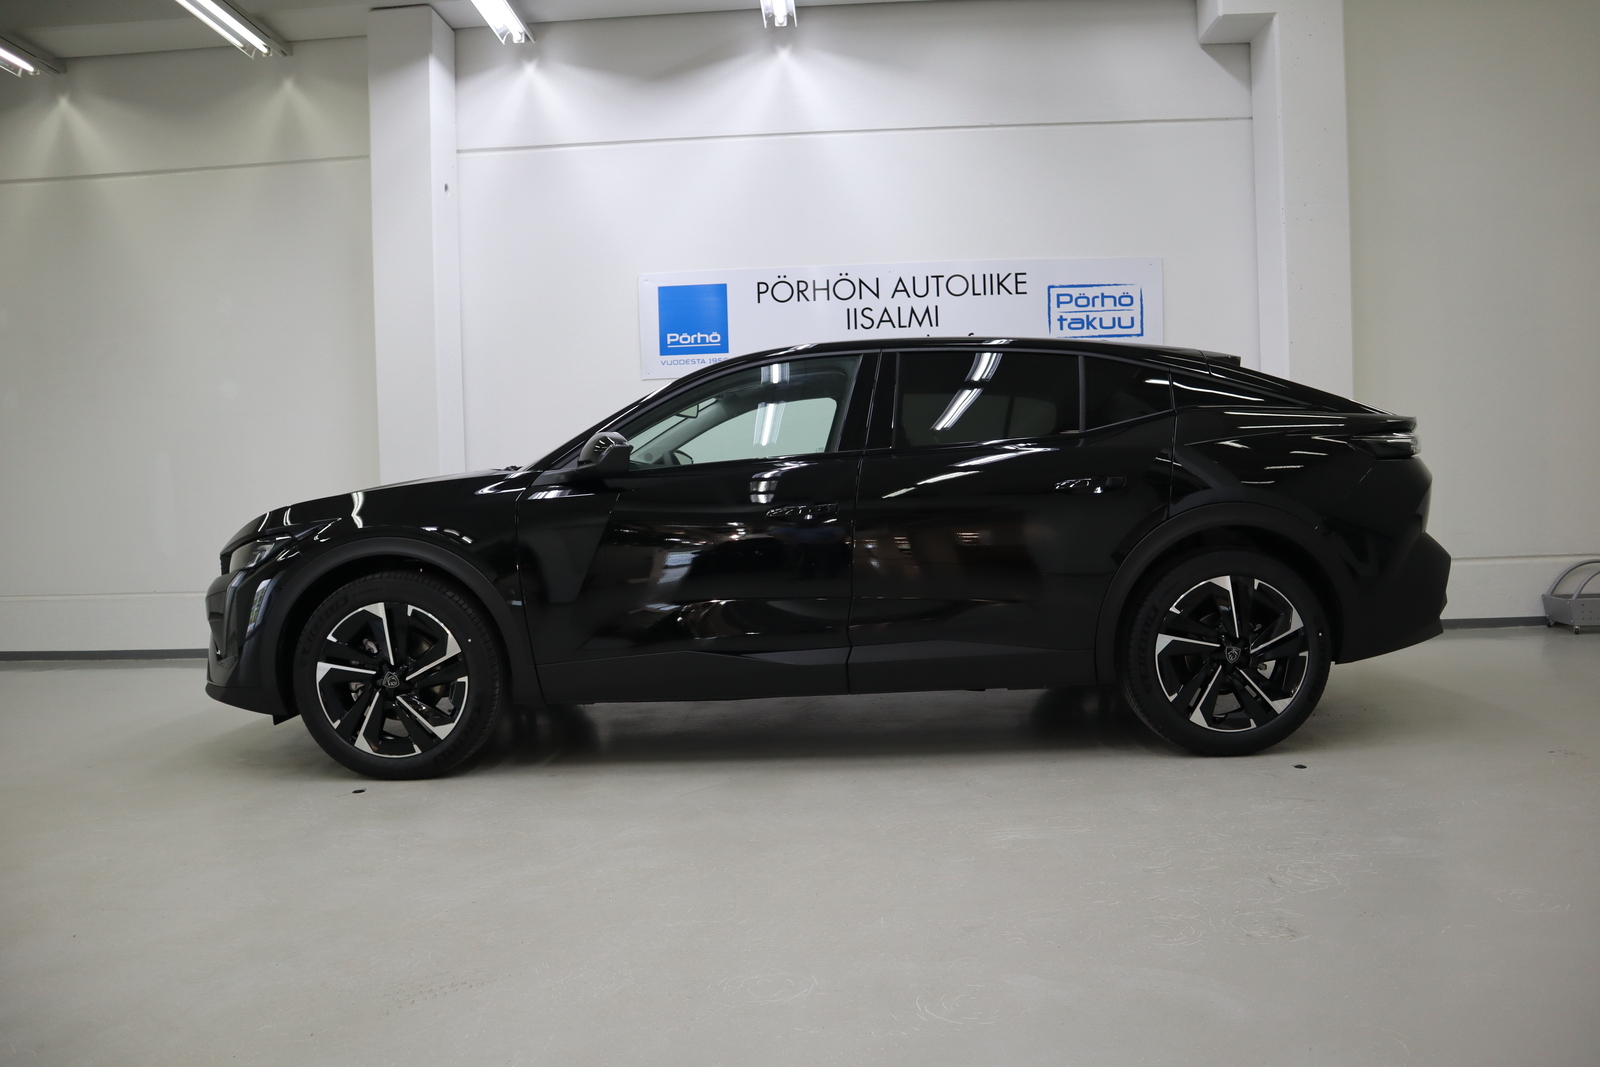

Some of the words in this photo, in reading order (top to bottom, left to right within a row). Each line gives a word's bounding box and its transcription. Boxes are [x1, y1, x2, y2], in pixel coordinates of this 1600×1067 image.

[757, 272, 880, 304] PÖRHÖN
[891, 272, 1028, 299] AUTOLIIKE
[1056, 291, 1134, 308] Pörhö
[846, 305, 939, 330] IISALMI
[1057, 314, 1135, 331] takuu
[667, 331, 721, 345] Pörhö
[660, 358, 706, 366] VUODESTA
